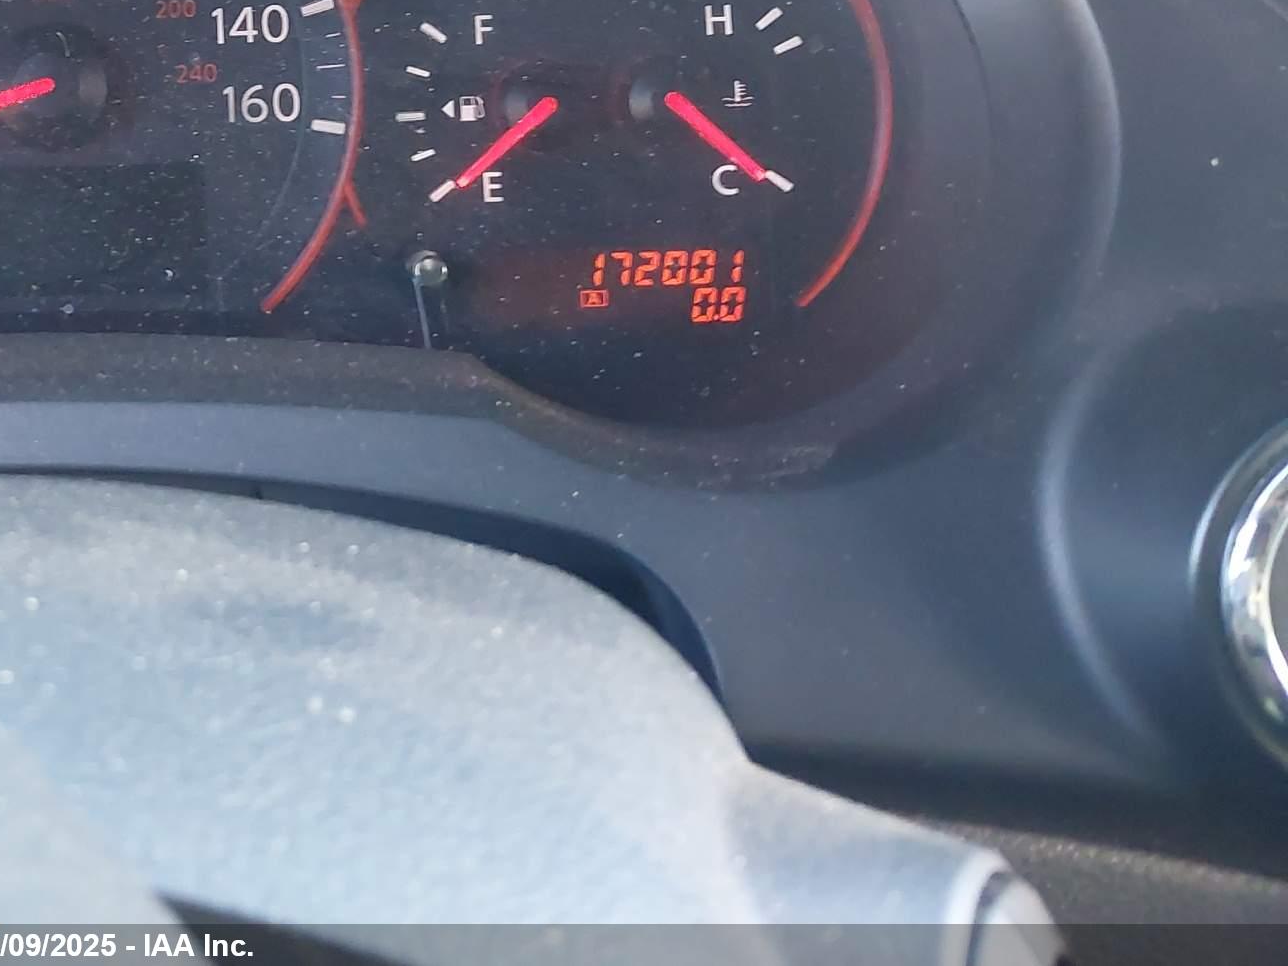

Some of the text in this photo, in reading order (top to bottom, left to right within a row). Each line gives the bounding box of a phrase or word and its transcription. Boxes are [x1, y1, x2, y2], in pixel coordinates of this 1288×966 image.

[156, 0, 196, 18] 200
[705, 5, 733, 35] H
[211, 5, 290, 44] 140
[474, 14, 493, 44] F
[176, 64, 217, 82] 240
[223, 83, 300, 123] 160
[483, 172, 504, 202] E
[712, 165, 739, 196] C
[593, 249, 745, 286] 172001
[692, 287, 746, 322] 0.0
